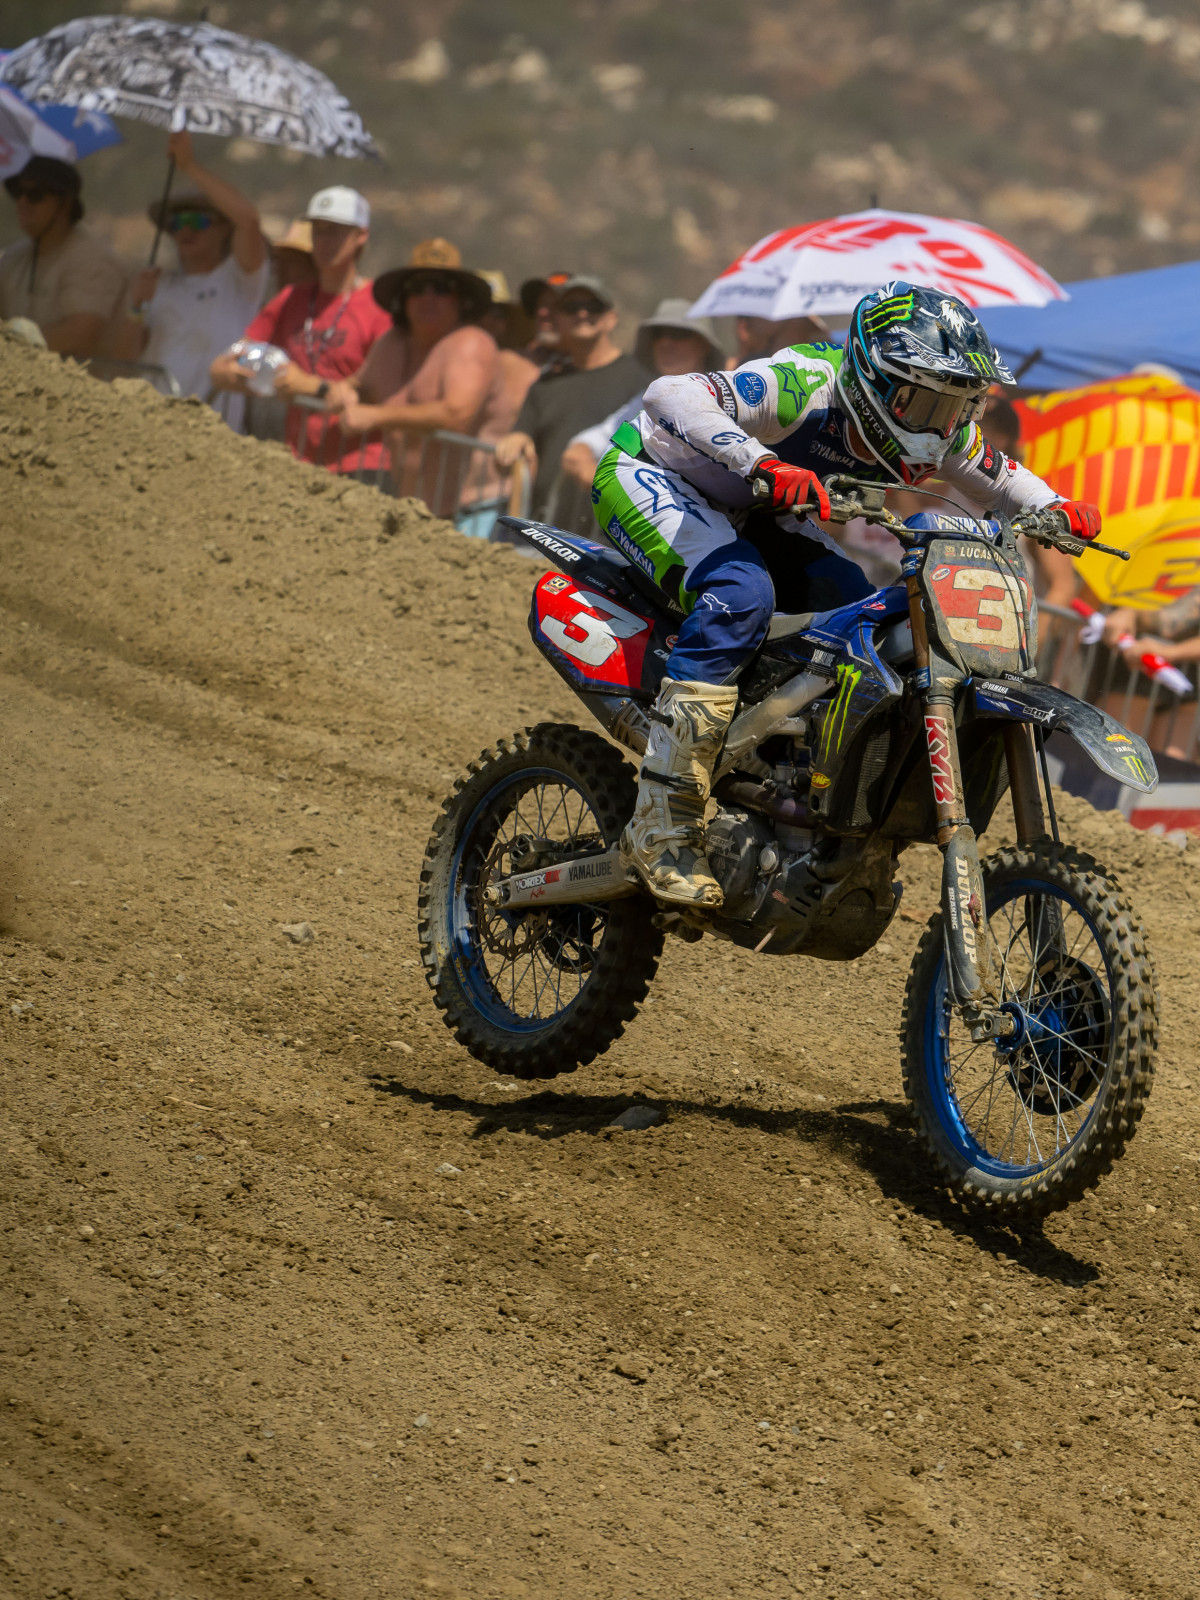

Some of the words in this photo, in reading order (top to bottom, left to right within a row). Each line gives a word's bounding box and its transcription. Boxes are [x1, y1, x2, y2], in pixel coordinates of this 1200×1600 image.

[749, 375, 762, 392] BLU
[850, 380, 886, 440] MONSTER
[520, 527, 582, 563] DUNLOP
[620, 531, 653, 577] YAMAHA
[960, 546, 992, 561] LUCAS
[585, 575, 608, 589] TOMAC
[946, 568, 1029, 650] 3
[540, 590, 649, 667] 3
[987, 681, 1010, 695] YAMAHA
[1004, 673, 1025, 684] TOMAC
[1022, 704, 1050, 720] star
[924, 715, 956, 804] KYB
[515, 873, 546, 894] VORTEX
[568, 860, 613, 881] YAMALUBE
[947, 886, 958, 931] BRAKING
[955, 856, 978, 964] DUNLOP
